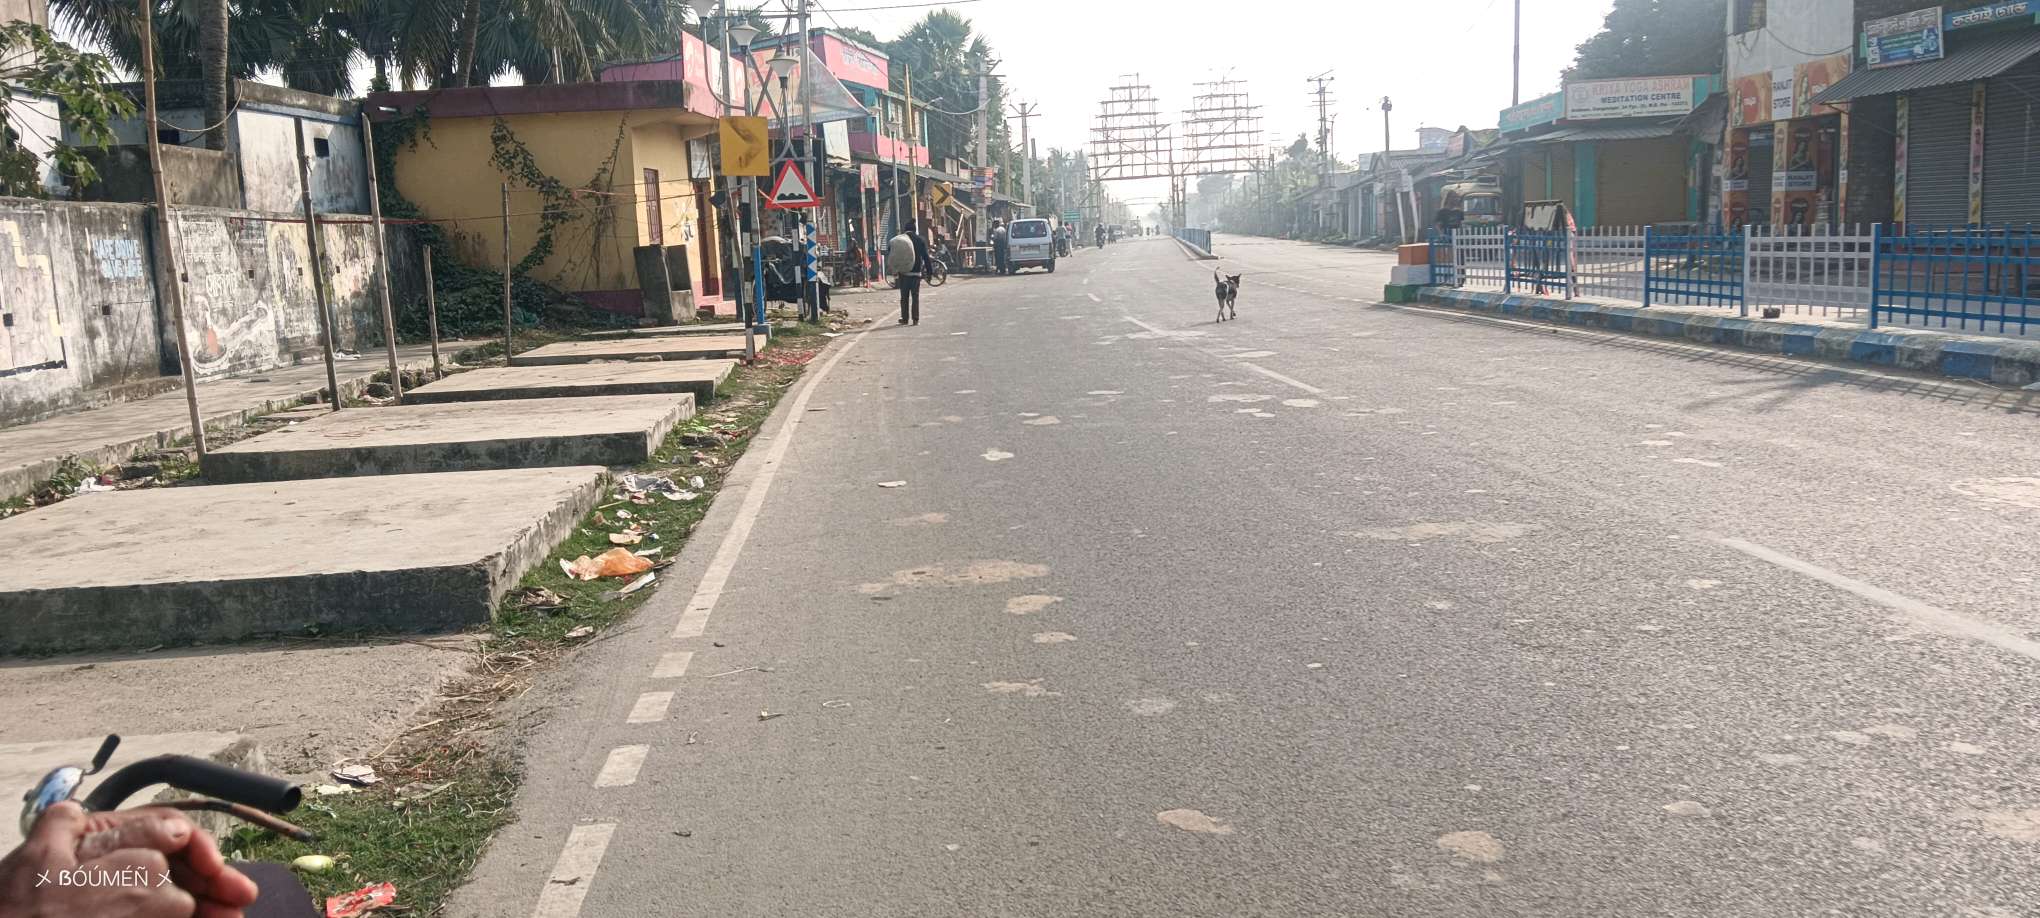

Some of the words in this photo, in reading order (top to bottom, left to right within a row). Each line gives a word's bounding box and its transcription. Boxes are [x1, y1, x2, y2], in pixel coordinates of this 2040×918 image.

[1623, 80, 1649, 93] YOGA
[1651, 78, 1690, 91] ASHRAM
[1601, 94, 1649, 104] MEDITATION
[1651, 92, 1681, 101] CENTRE
[1773, 96, 1791, 109] STORE
